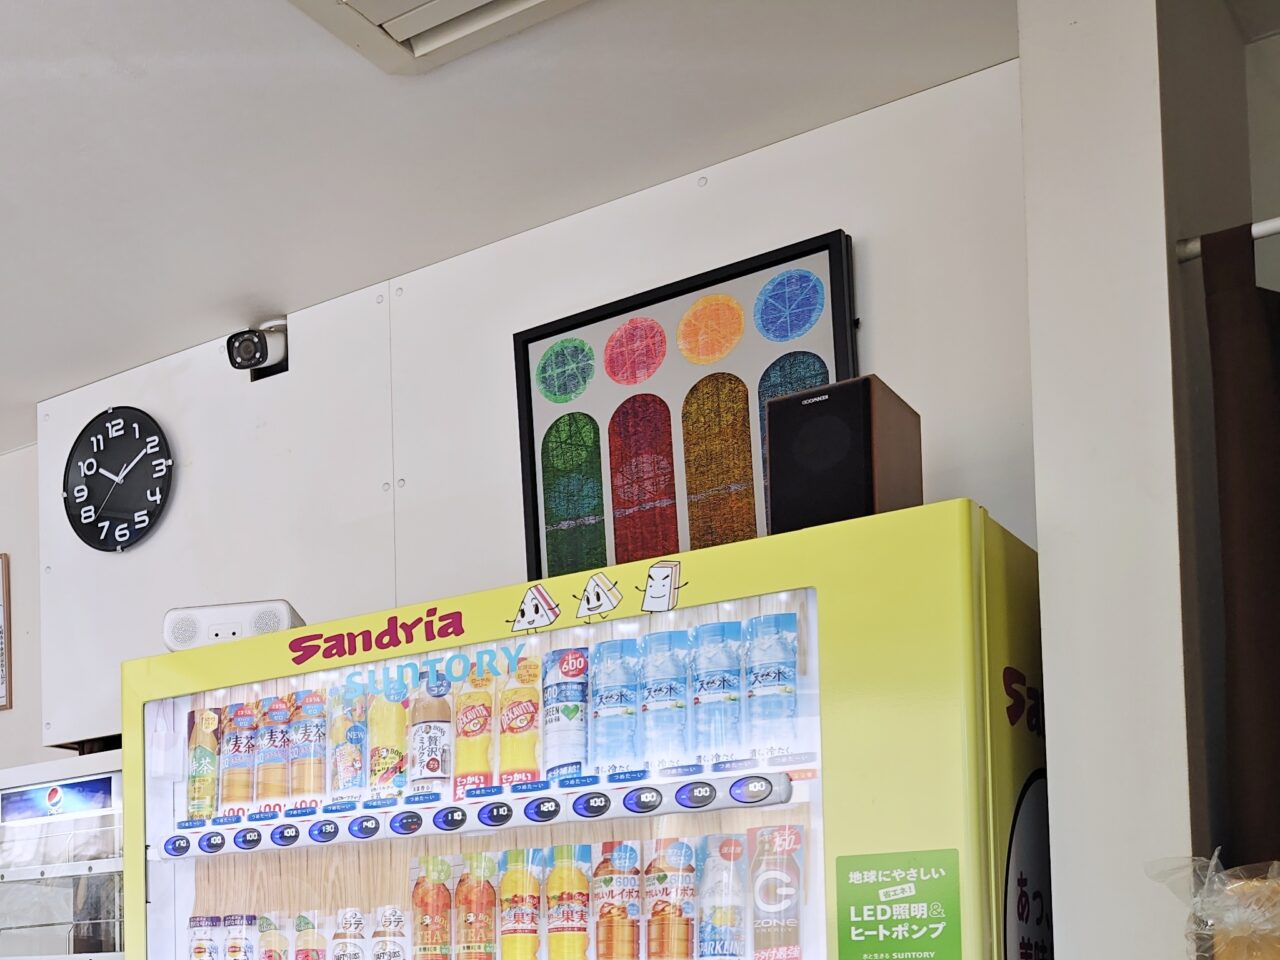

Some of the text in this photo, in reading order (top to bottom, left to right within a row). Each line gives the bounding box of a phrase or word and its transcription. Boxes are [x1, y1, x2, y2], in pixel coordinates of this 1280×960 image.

[106, 418, 124, 438] 12
[132, 423, 140, 439] 1
[90, 434, 104, 452] 11
[146, 435, 159, 454] 2
[78, 457, 97, 477] 10
[151, 458, 167, 478] 3
[74, 484, 88, 503] 9
[146, 487, 161, 505] 4
[80, 505, 95, 524] 8
[134, 509, 149, 529] 5
[97, 520, 110, 540] 7
[115, 523, 130, 542] 6
[289, 606, 465, 665] Sandria
[345, 643, 525, 700] SUNTORY
[561, 657, 584, 673] 600
[698, 676, 733, 692] 天然水
[752, 669, 787, 685] 天然水
[598, 691, 632, 706] 天然水
[646, 685, 680, 700] 天然水
[266, 728, 290, 749] 麦茶
[300, 723, 326, 743] 麦茶
[347, 730, 365, 740] NEW
[231, 735, 255, 754] 麦茶
[693, 787, 710, 797] 100
[748, 782, 766, 792] 100
[589, 798, 605, 807] 100
[640, 793, 657, 802] 100
[493, 807, 508, 815] 110
[540, 802, 555, 811] 120
[448, 811, 462, 820] 110
[246, 832, 258, 840] 100
[284, 828, 296, 837] 100
[322, 824, 335, 833] 130
[211, 836, 222, 844] 100
[849, 867, 946, 884] 地球にやさしい
[883, 885, 913, 899] 省エネ!
[343, 918, 364, 929] ラテ
[383, 916, 404, 928] ラテ
[851, 921, 947, 941] ヒートポンプ
[892, 951, 935, 960] SUNTORY
